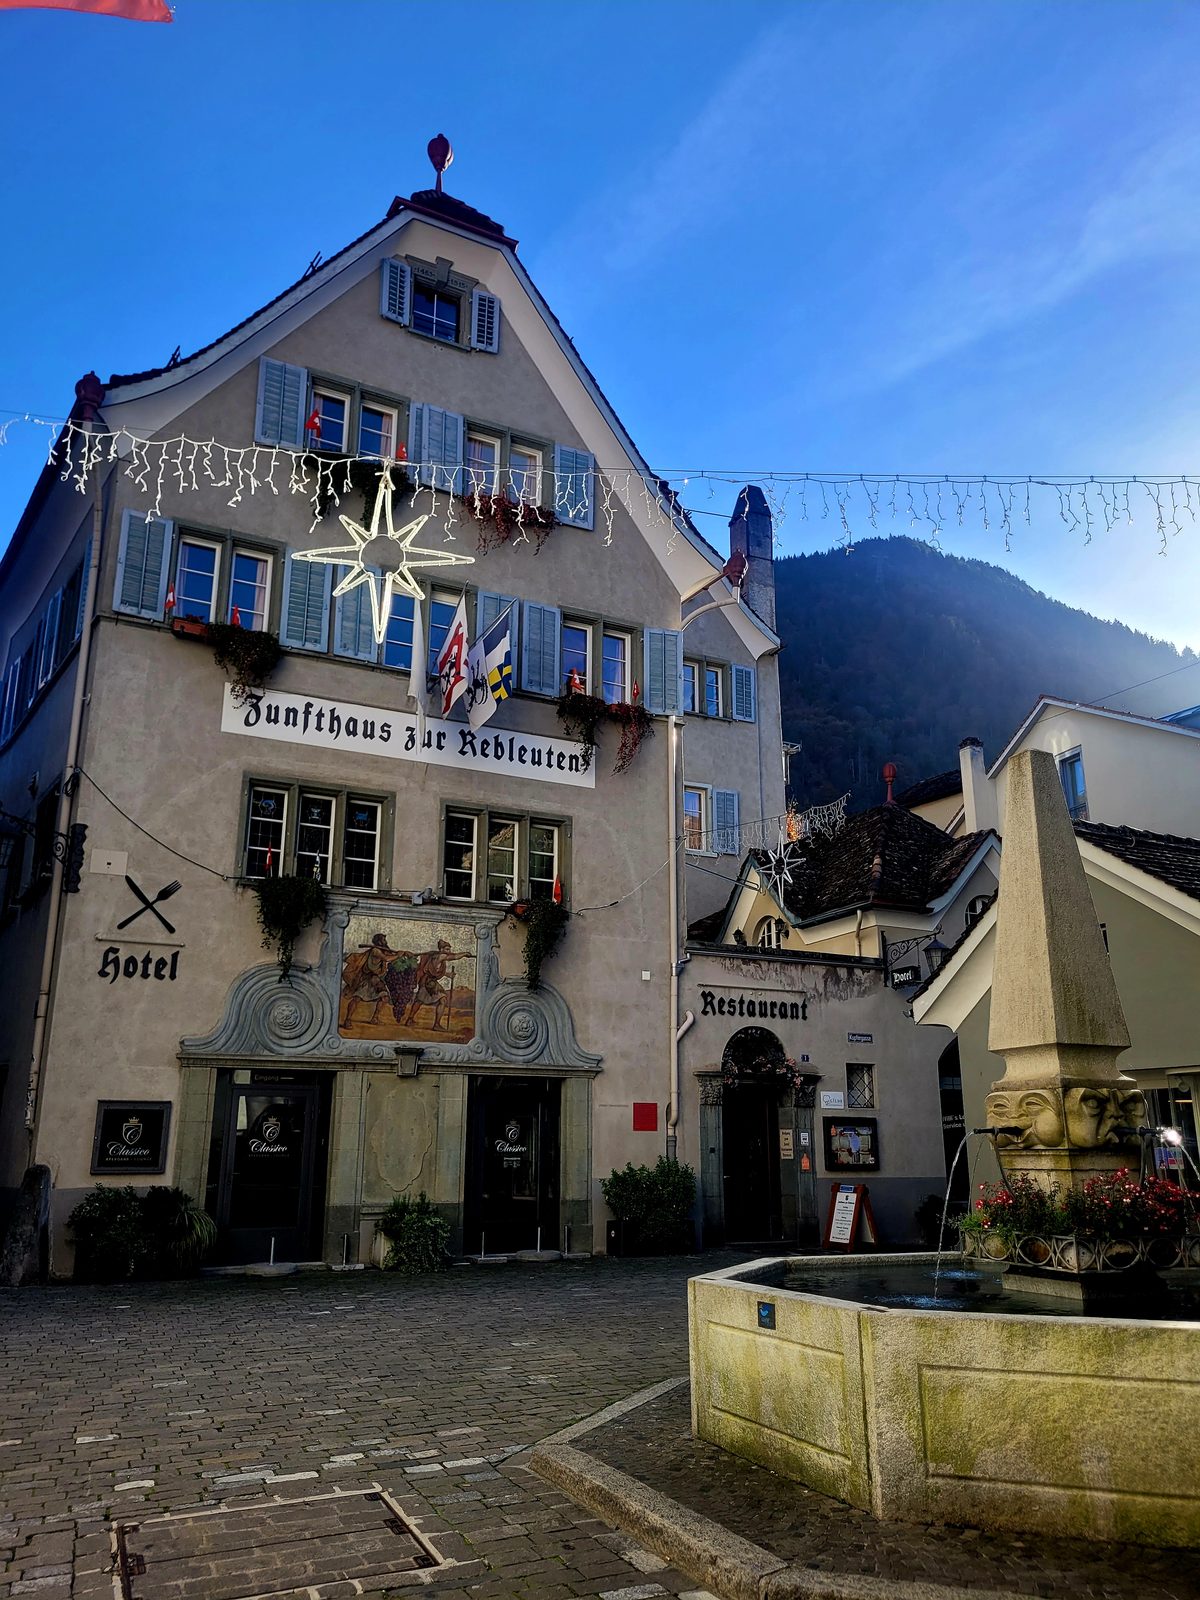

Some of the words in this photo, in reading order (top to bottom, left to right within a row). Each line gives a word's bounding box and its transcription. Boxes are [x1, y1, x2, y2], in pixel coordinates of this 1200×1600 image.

[243, 694, 392, 742] Zunfthaus
[404, 726, 447, 751] zur
[458, 728, 581, 773] Rebleuten
[97, 946, 180, 985] Hotel
[700, 990, 808, 1021] Restaurant
[106, 1141, 151, 1156] Classico
[248, 1138, 288, 1153] Classico
[494, 1139, 528, 1153] Classico
